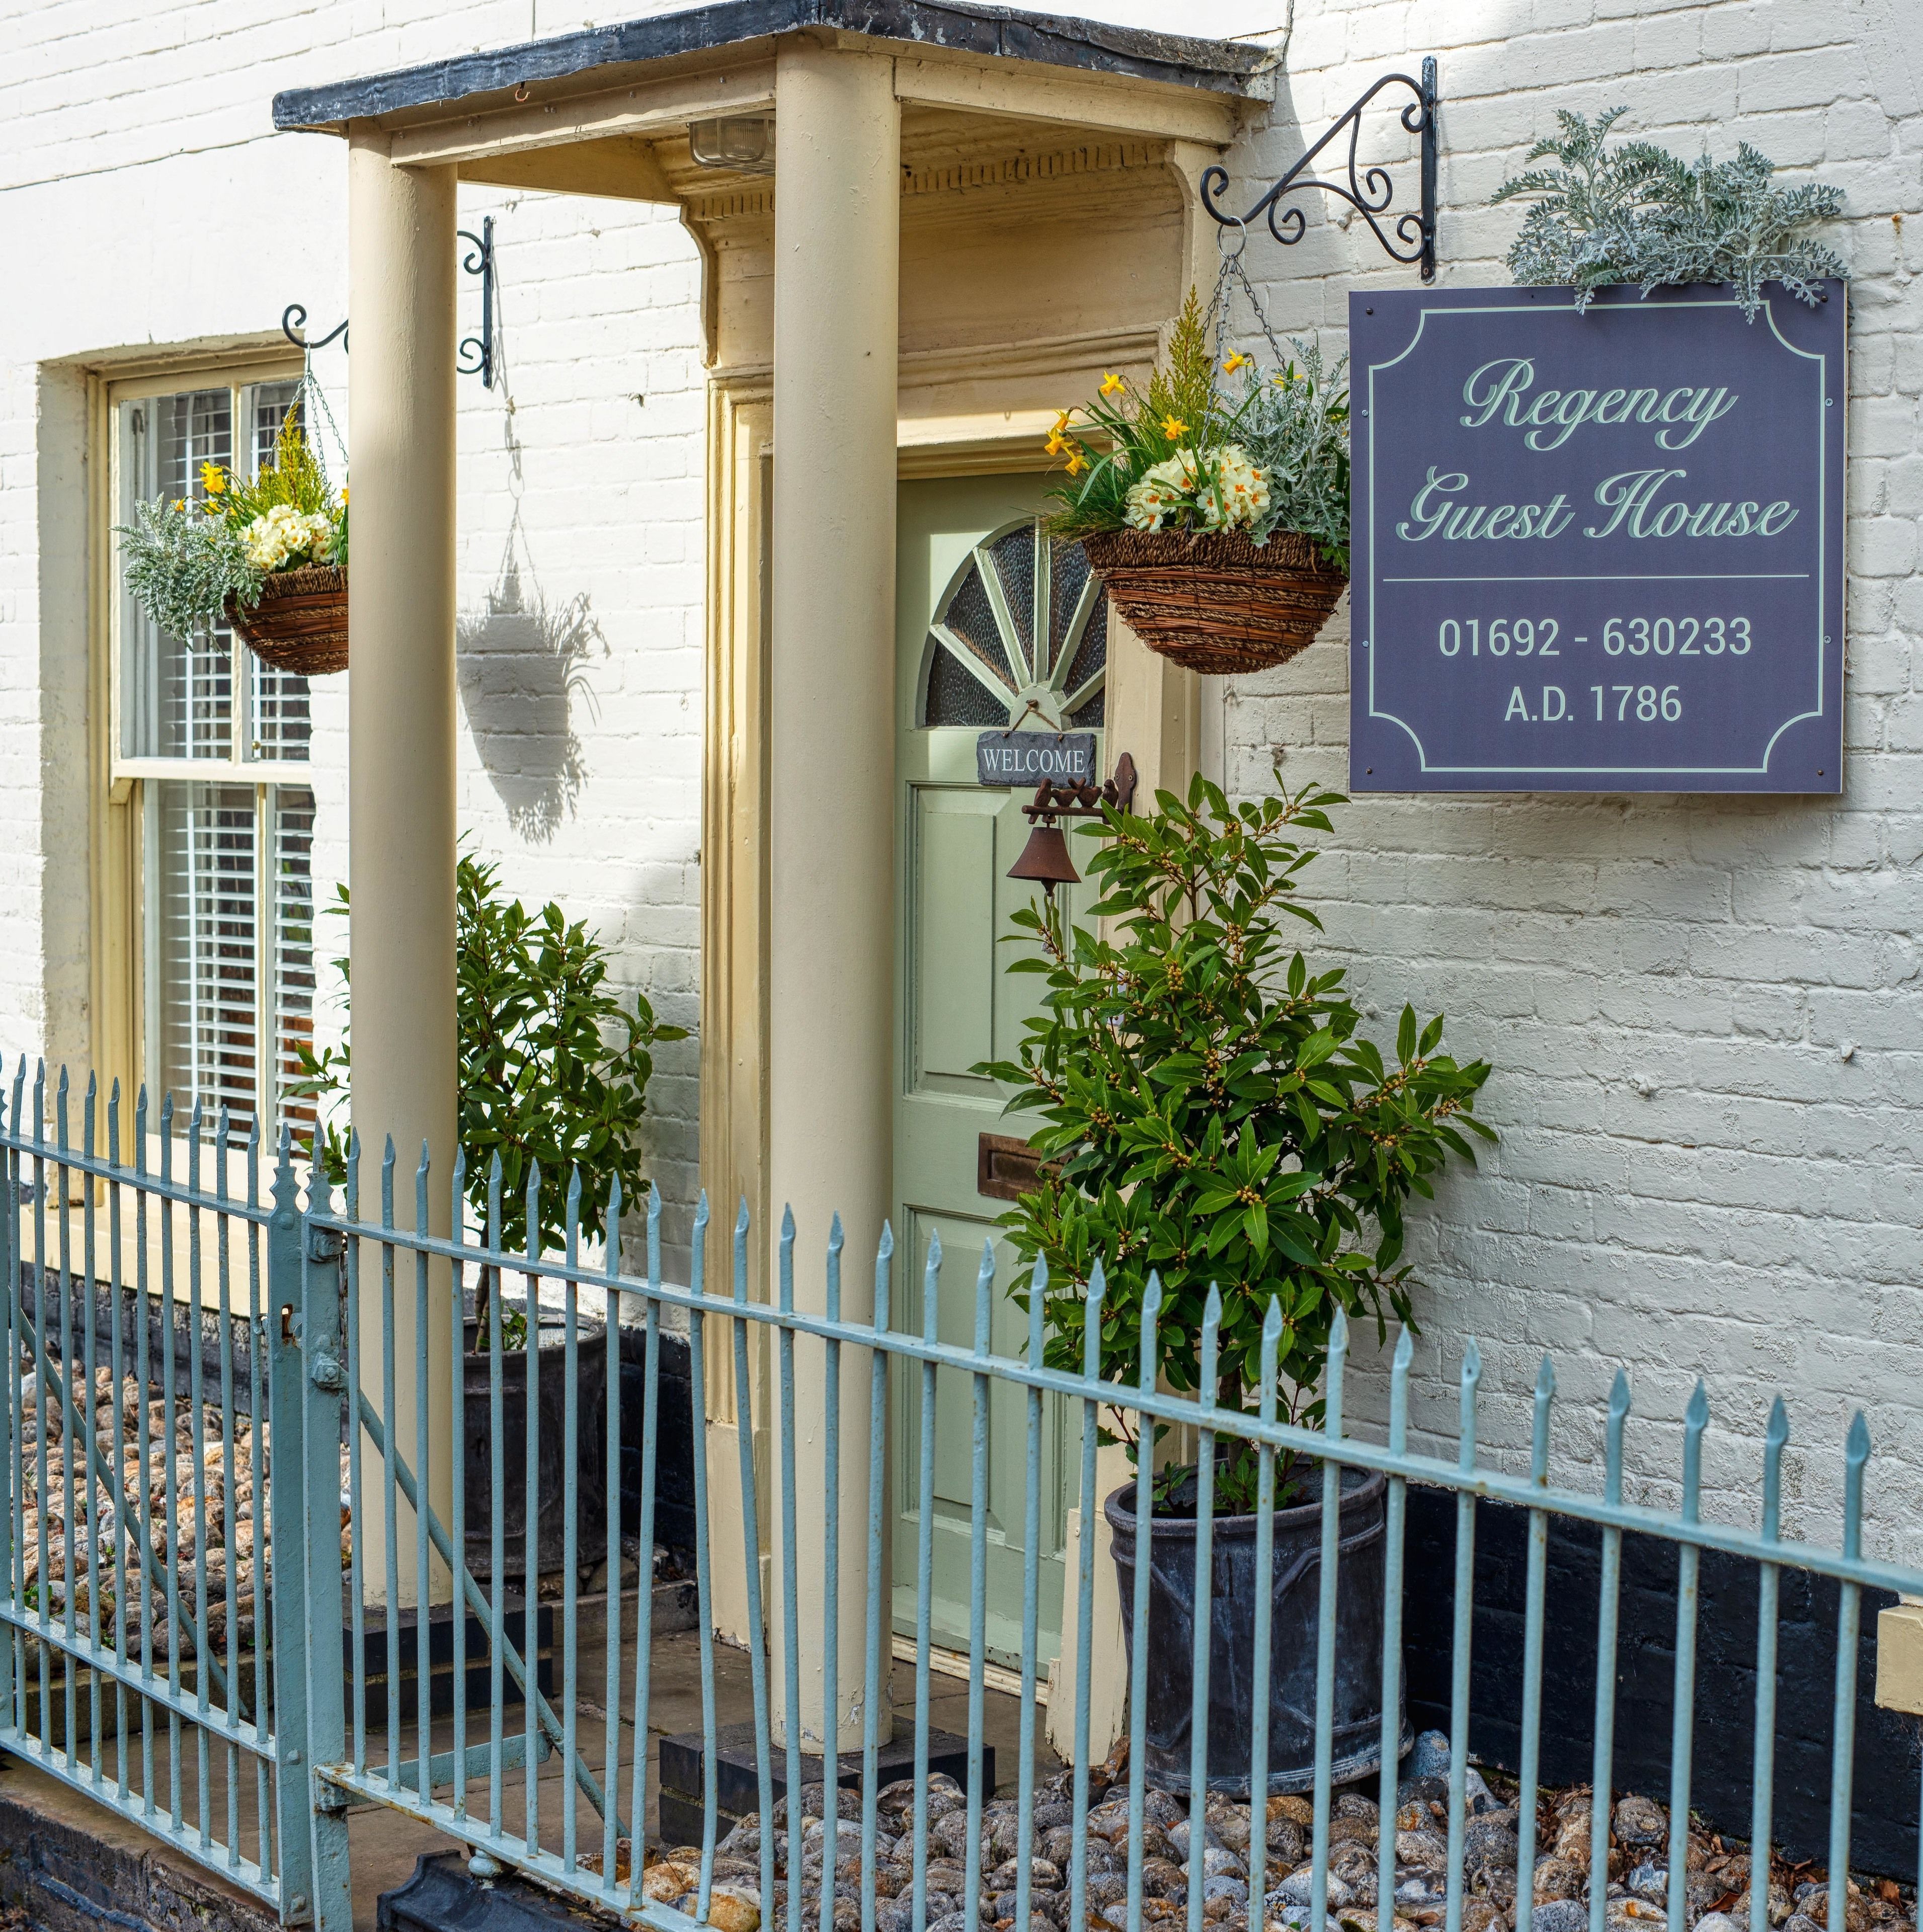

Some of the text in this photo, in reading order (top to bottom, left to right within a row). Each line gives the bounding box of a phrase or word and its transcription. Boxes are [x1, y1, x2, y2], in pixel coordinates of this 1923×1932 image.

[1459, 358, 1739, 451] Regency
[1396, 465, 1800, 541] Guest House
[1439, 618, 1560, 657] 01692
[1603, 617, 1751, 656] 630233
[1504, 685, 1682, 721] A.D. 1786
[983, 749, 1085, 773] WELCOME
